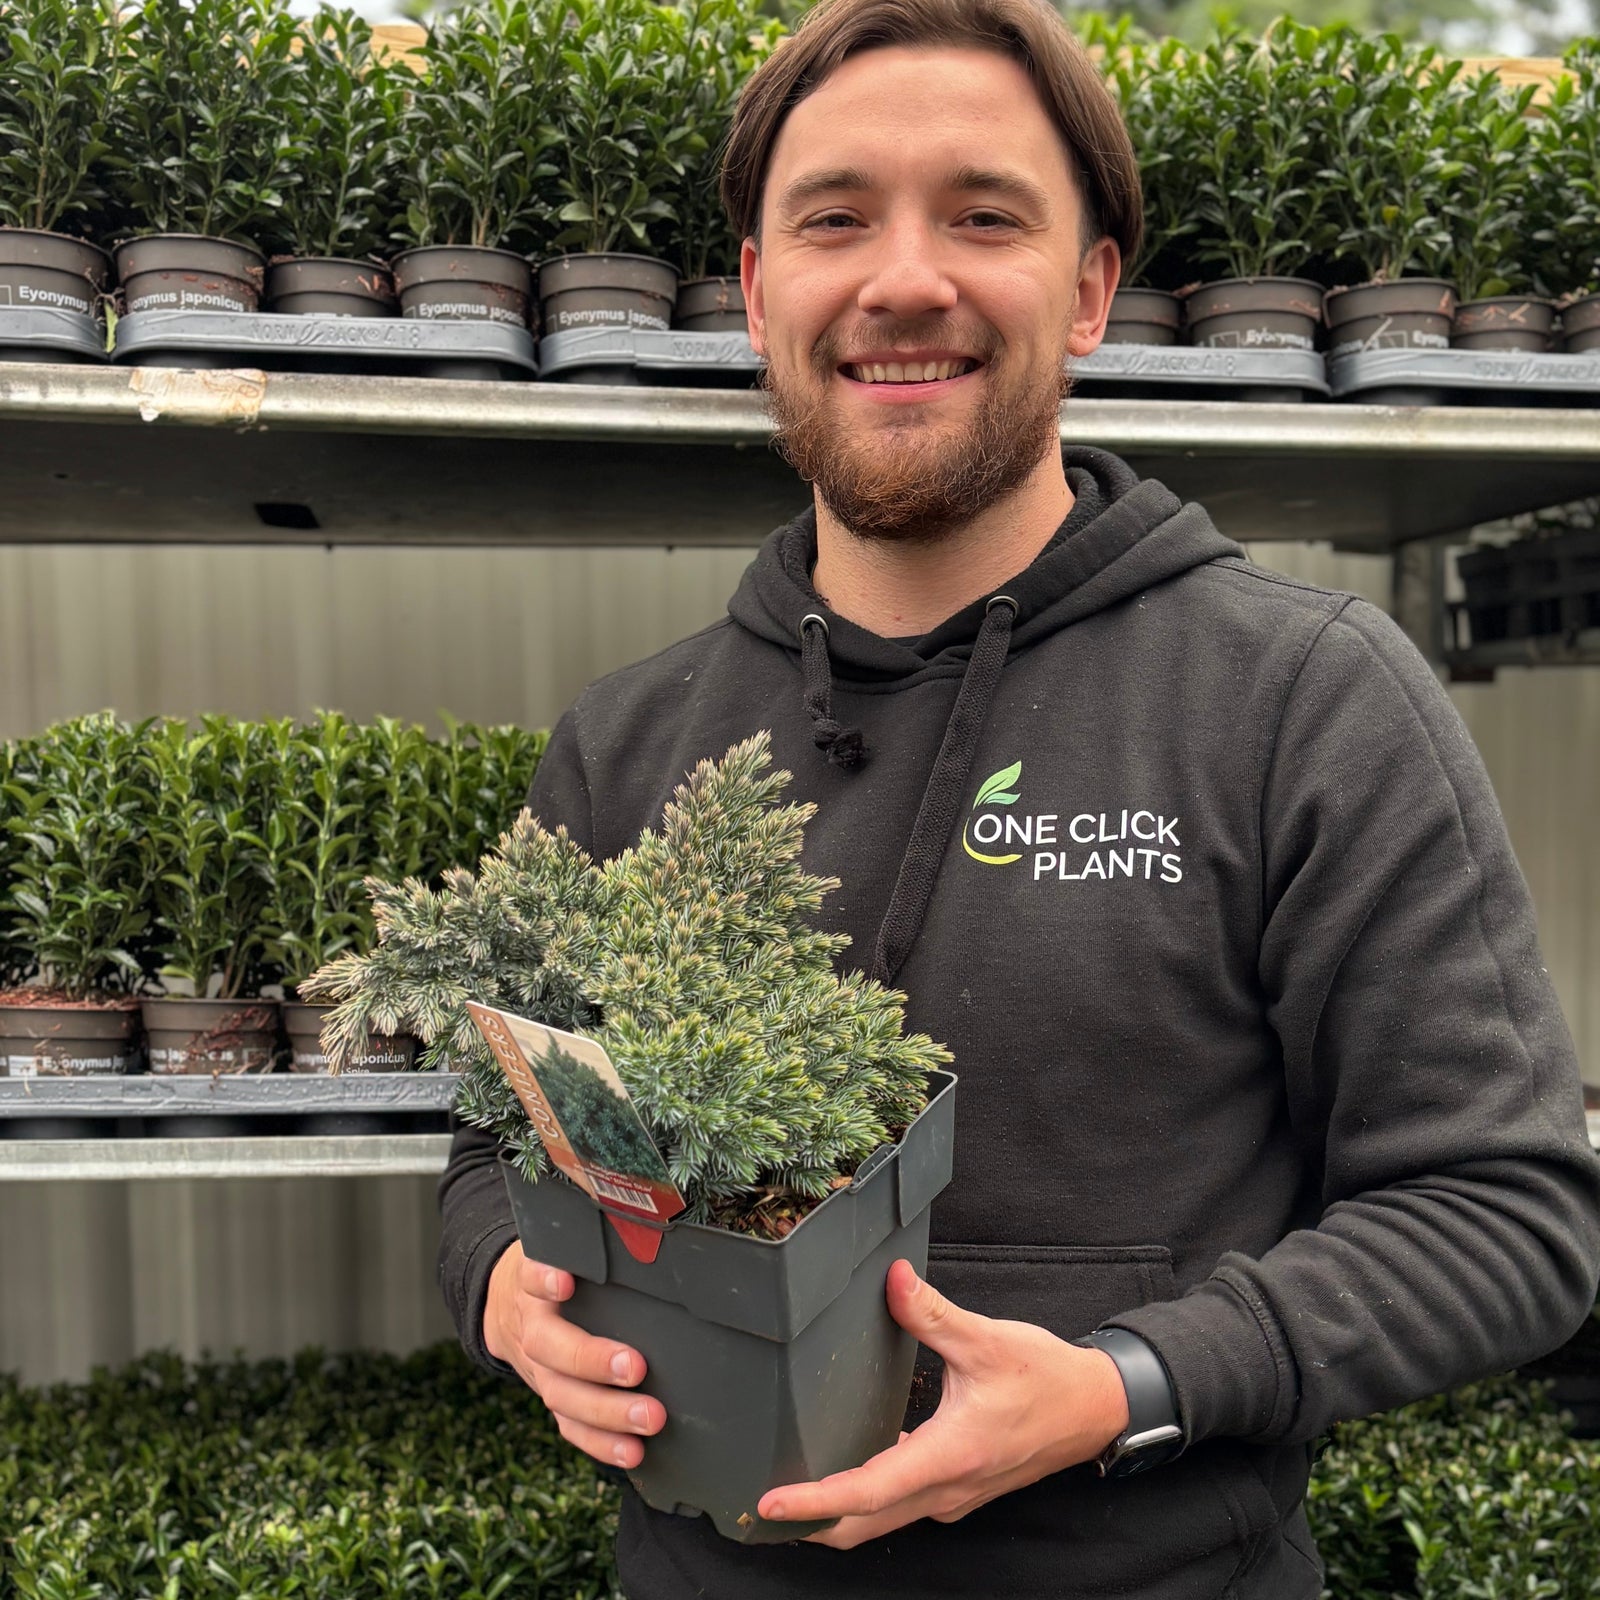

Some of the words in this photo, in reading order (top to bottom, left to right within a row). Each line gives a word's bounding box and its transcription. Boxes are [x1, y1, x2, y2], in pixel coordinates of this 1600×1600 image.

[18, 286, 89, 311] Eyonymus
[180, 290, 244, 312] japonicus
[419, 302, 487, 317] Eyonymus
[559, 310, 625, 326] Eyonymus
[973, 814, 1058, 845] ONE
[1069, 809, 1181, 846] CLICK
[1033, 847, 1183, 884] PLANTS
[347, 1052, 406, 1066] aponicus
[479, 1014, 560, 1139] CONIFERS
